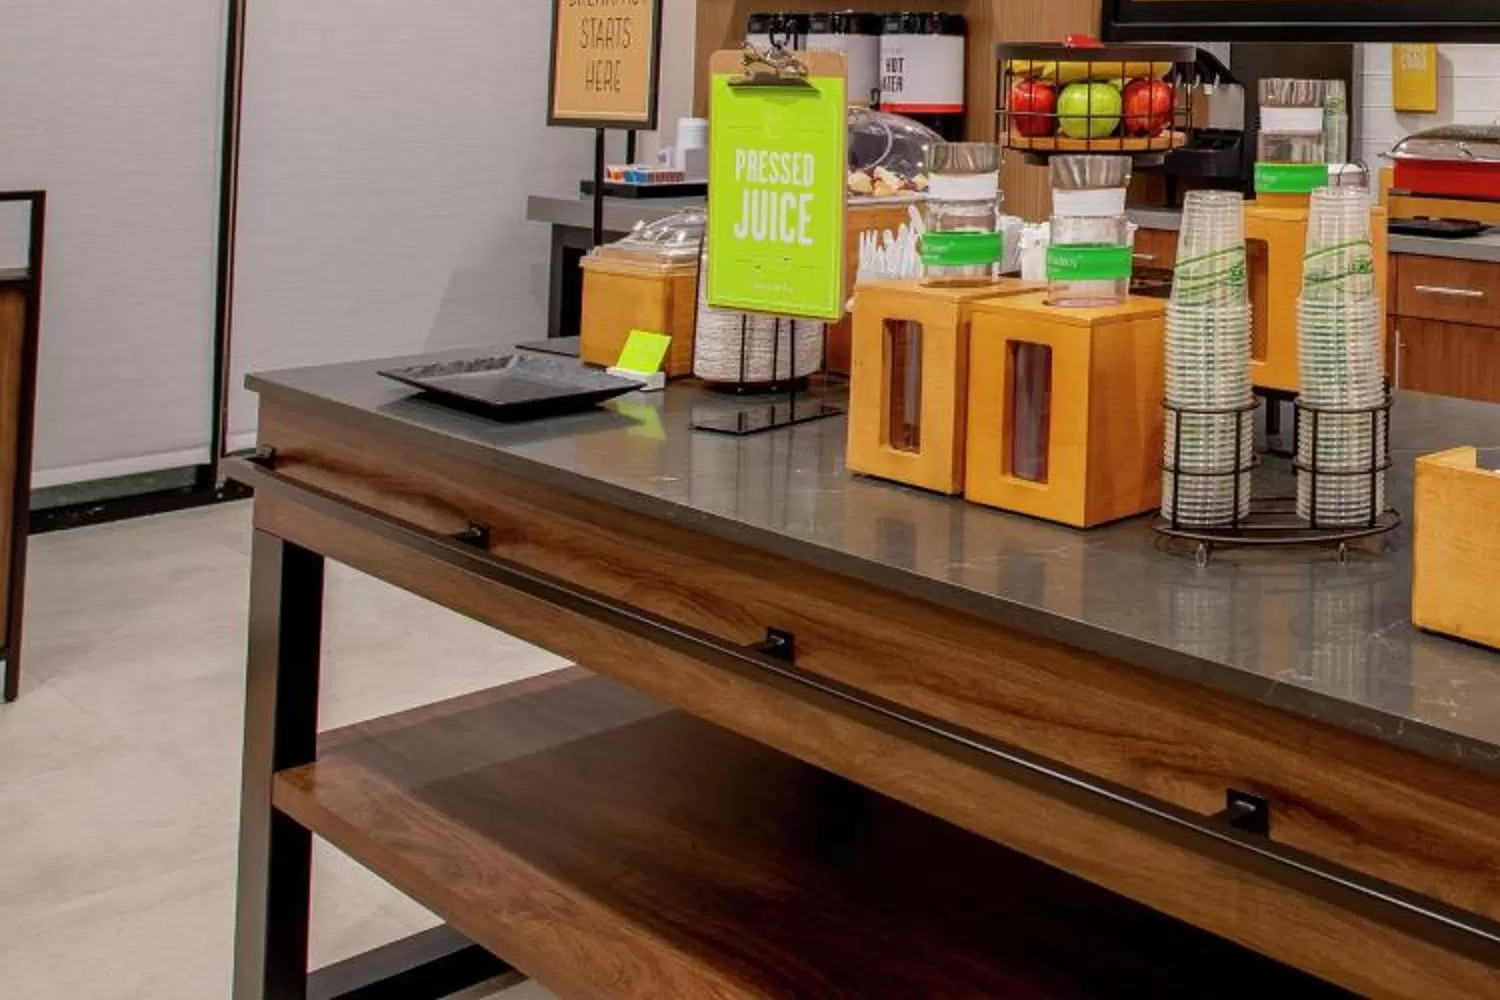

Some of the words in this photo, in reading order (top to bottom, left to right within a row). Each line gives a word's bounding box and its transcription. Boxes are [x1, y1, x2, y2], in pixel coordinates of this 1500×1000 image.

[580, 16, 632, 49] STARTS
[584, 59, 622, 92] HERE
[885, 57, 905, 73] HOT
[881, 75, 904, 92] ATER
[735, 149, 816, 187] PRESSED
[733, 188, 815, 246] JUICE
